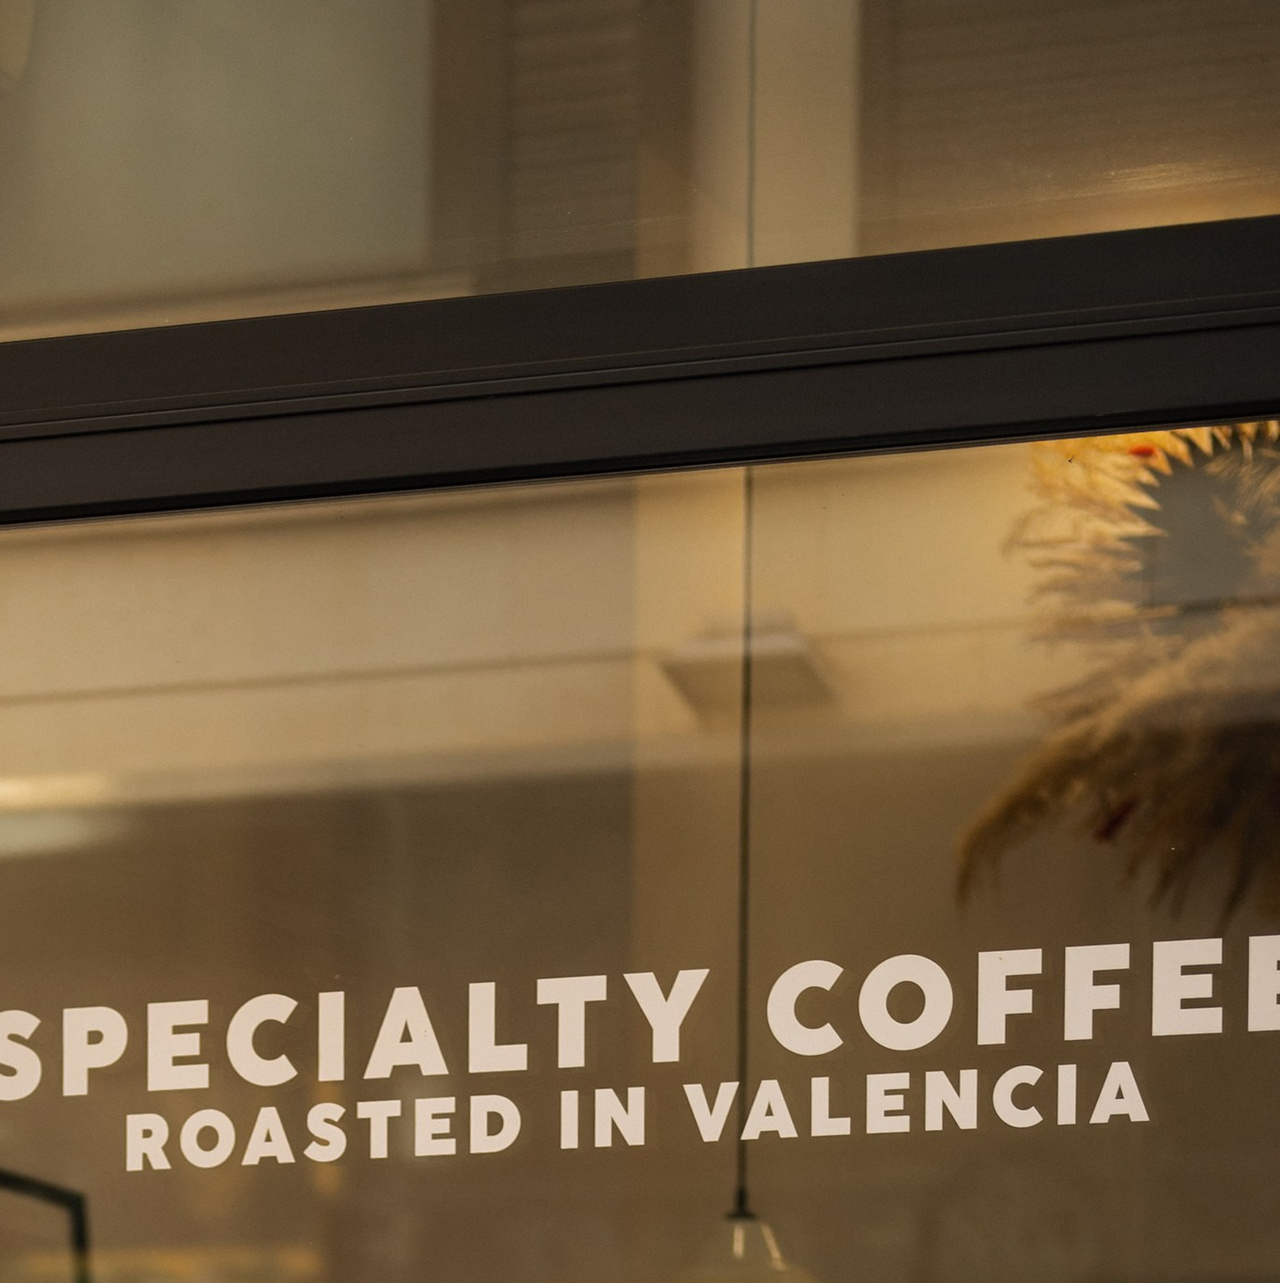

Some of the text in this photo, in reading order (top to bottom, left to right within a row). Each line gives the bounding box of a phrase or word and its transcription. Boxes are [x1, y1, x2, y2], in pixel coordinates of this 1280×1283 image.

[126, 1061, 1151, 1172] ROASTED IN VALENCIA
